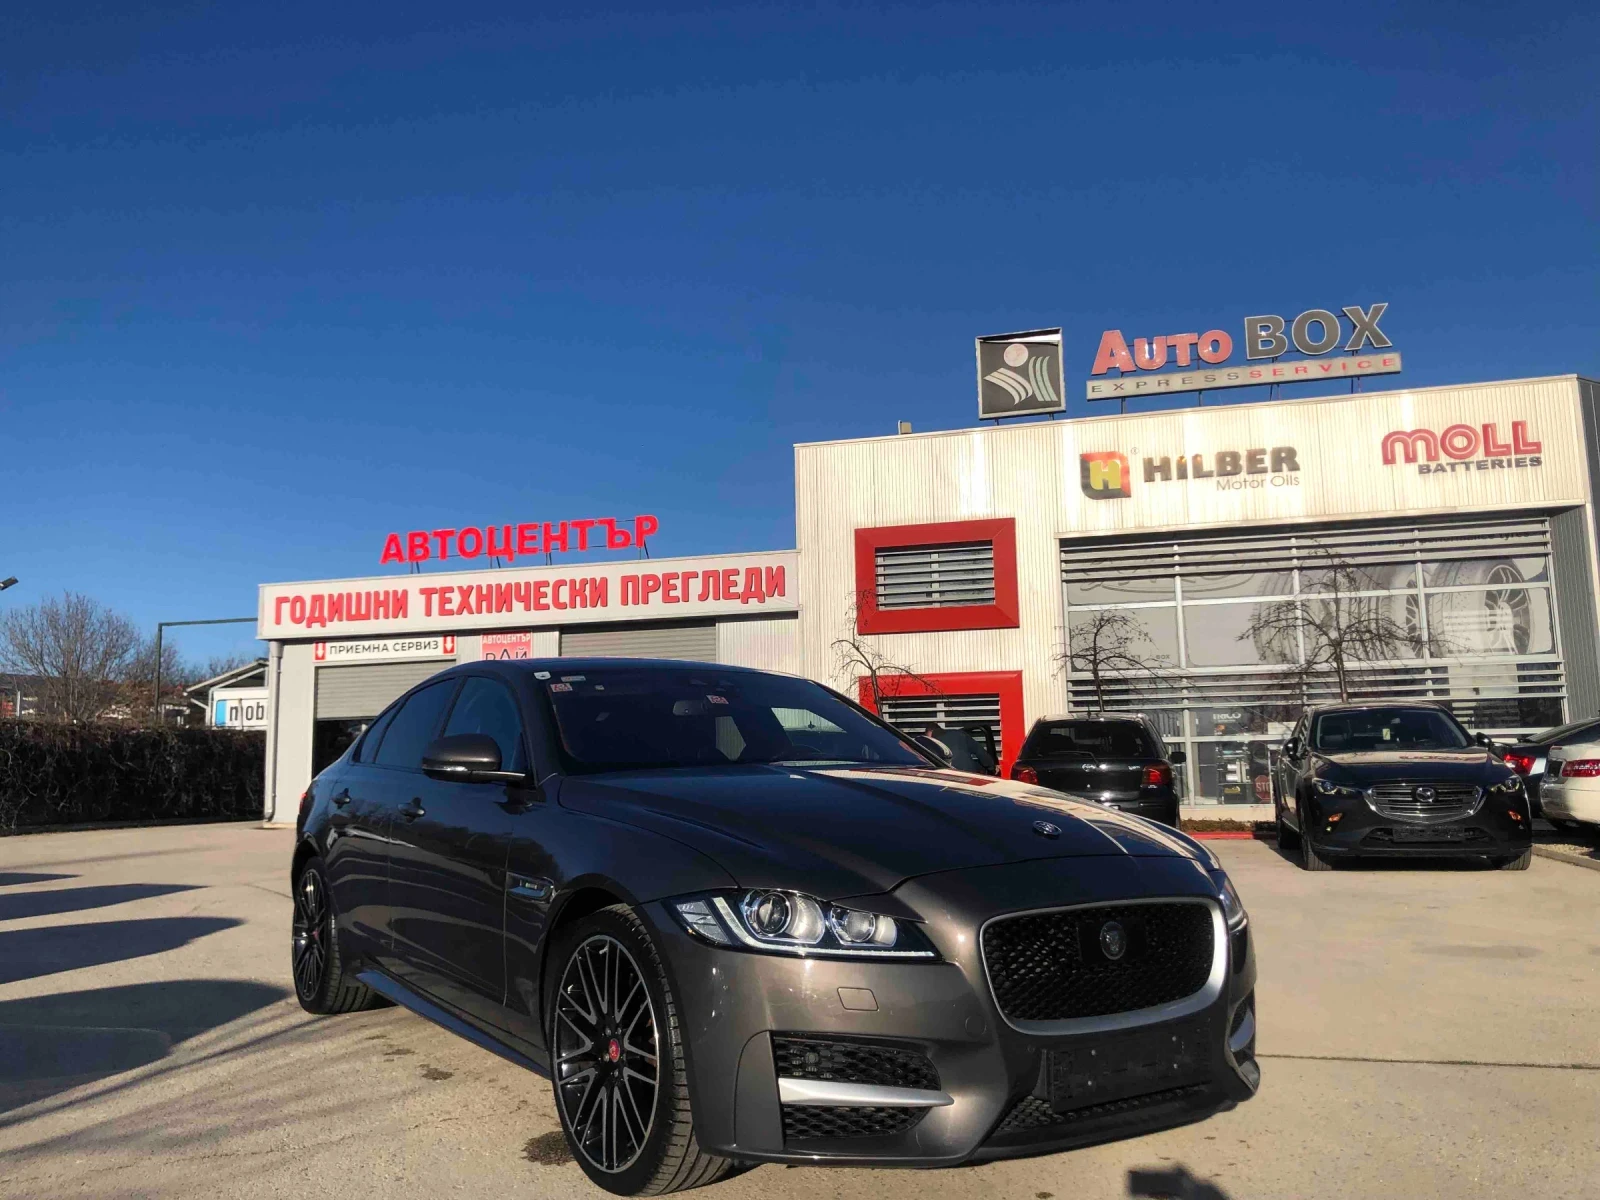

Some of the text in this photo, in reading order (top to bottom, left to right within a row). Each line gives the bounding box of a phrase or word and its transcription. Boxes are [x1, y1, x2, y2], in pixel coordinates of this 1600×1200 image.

[1244, 302, 1393, 360] BOX
[1417, 456, 1543, 475] BATTERIES
[1216, 474, 1300, 491] Motor Oils
[380, 515, 659, 564] АВТОЦЕНТЪР
[274, 565, 786, 629] ГОДИШНИ ТЕХНИЧЕСКИ ПРЕГЛЕДИ
[329, 640, 439, 655] ПРИЕМНА СЕРВИЗ
[229, 701, 268, 722] mob
